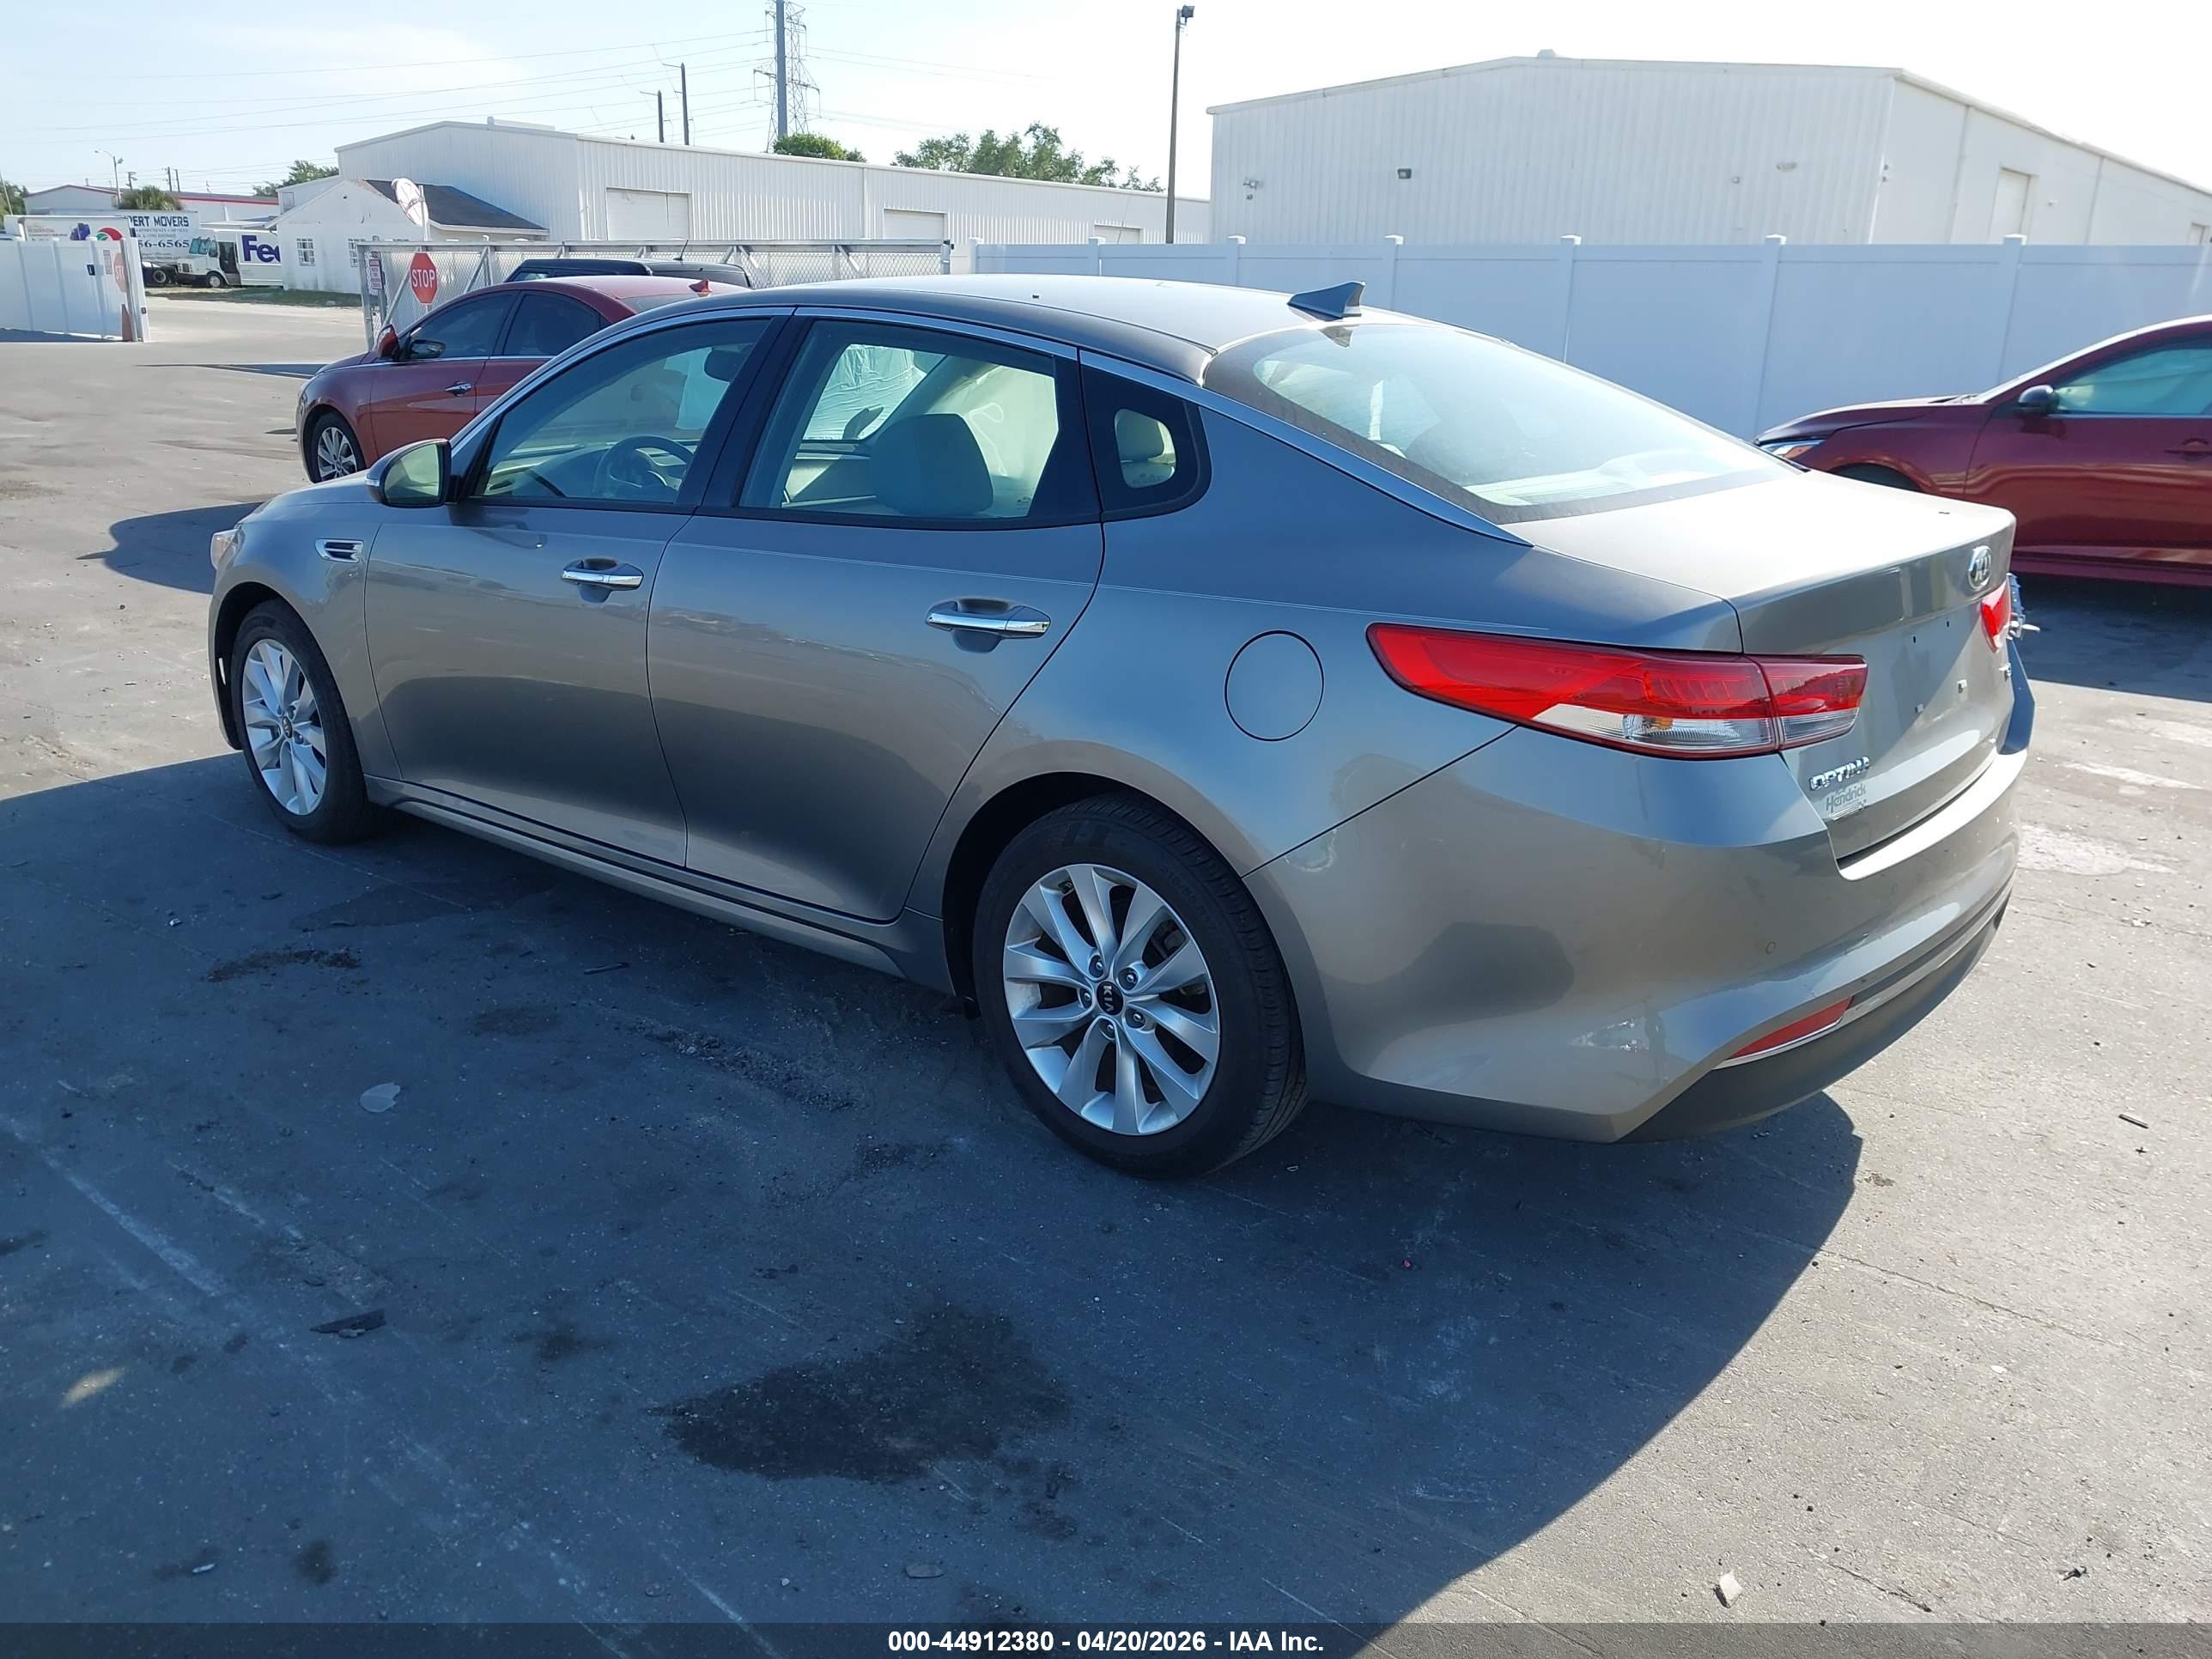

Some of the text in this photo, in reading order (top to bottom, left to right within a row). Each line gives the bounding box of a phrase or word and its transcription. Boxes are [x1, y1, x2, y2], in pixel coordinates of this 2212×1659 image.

[154, 216, 189, 227] MOVERS
[412, 269, 435, 289] STOP
[1809, 757, 1869, 790] OPTIMA
[1826, 782, 1867, 813] Hendrick
[1103, 985, 1115, 1012] KIA
